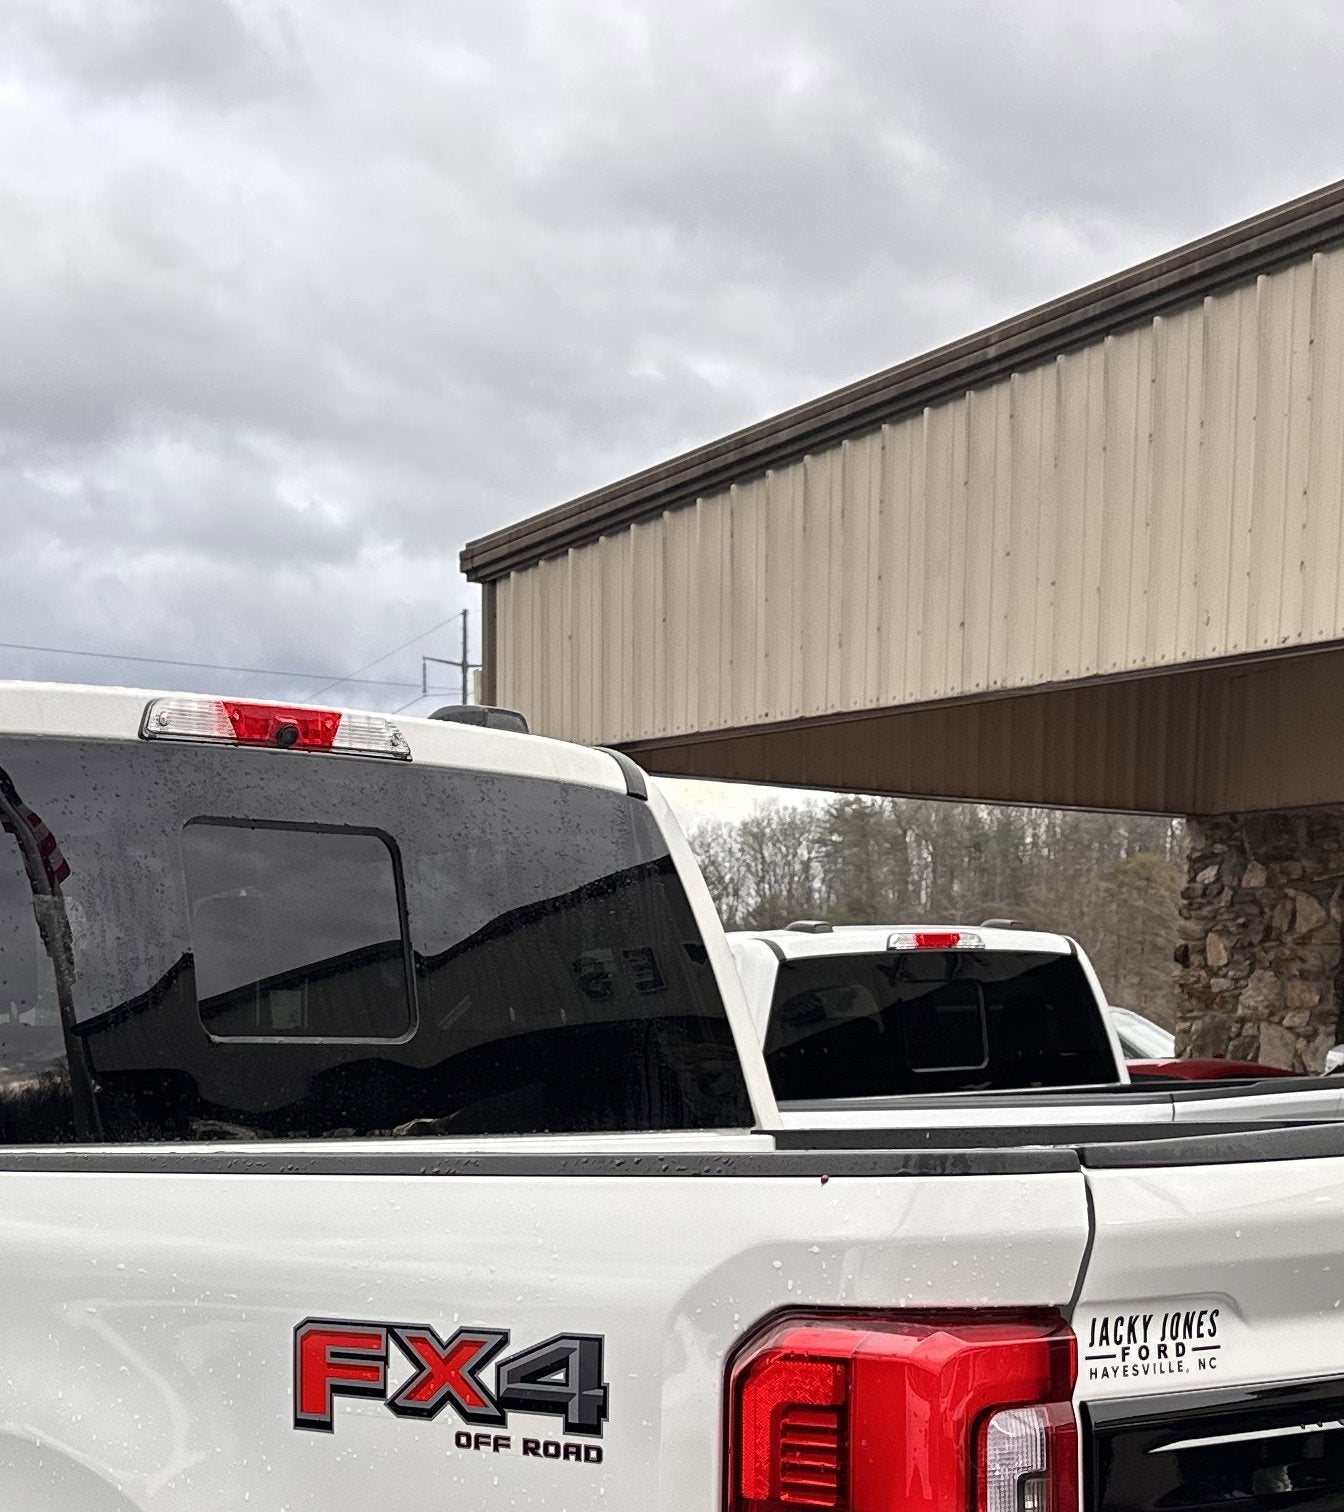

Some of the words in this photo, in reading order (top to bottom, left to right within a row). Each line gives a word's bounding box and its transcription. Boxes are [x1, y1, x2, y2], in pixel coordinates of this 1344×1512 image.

[1088, 1313, 1154, 1348] JACKY
[1160, 1308, 1220, 1342] JONES
[1089, 1360, 1190, 1380] HAYESVILLE,
[1197, 1356, 1218, 1371] NC
[1120, 1341, 1187, 1363] FORD
[292, 1315, 611, 1439] FX4
[454, 1430, 512, 1454] OFF
[522, 1436, 604, 1465] ROAD
